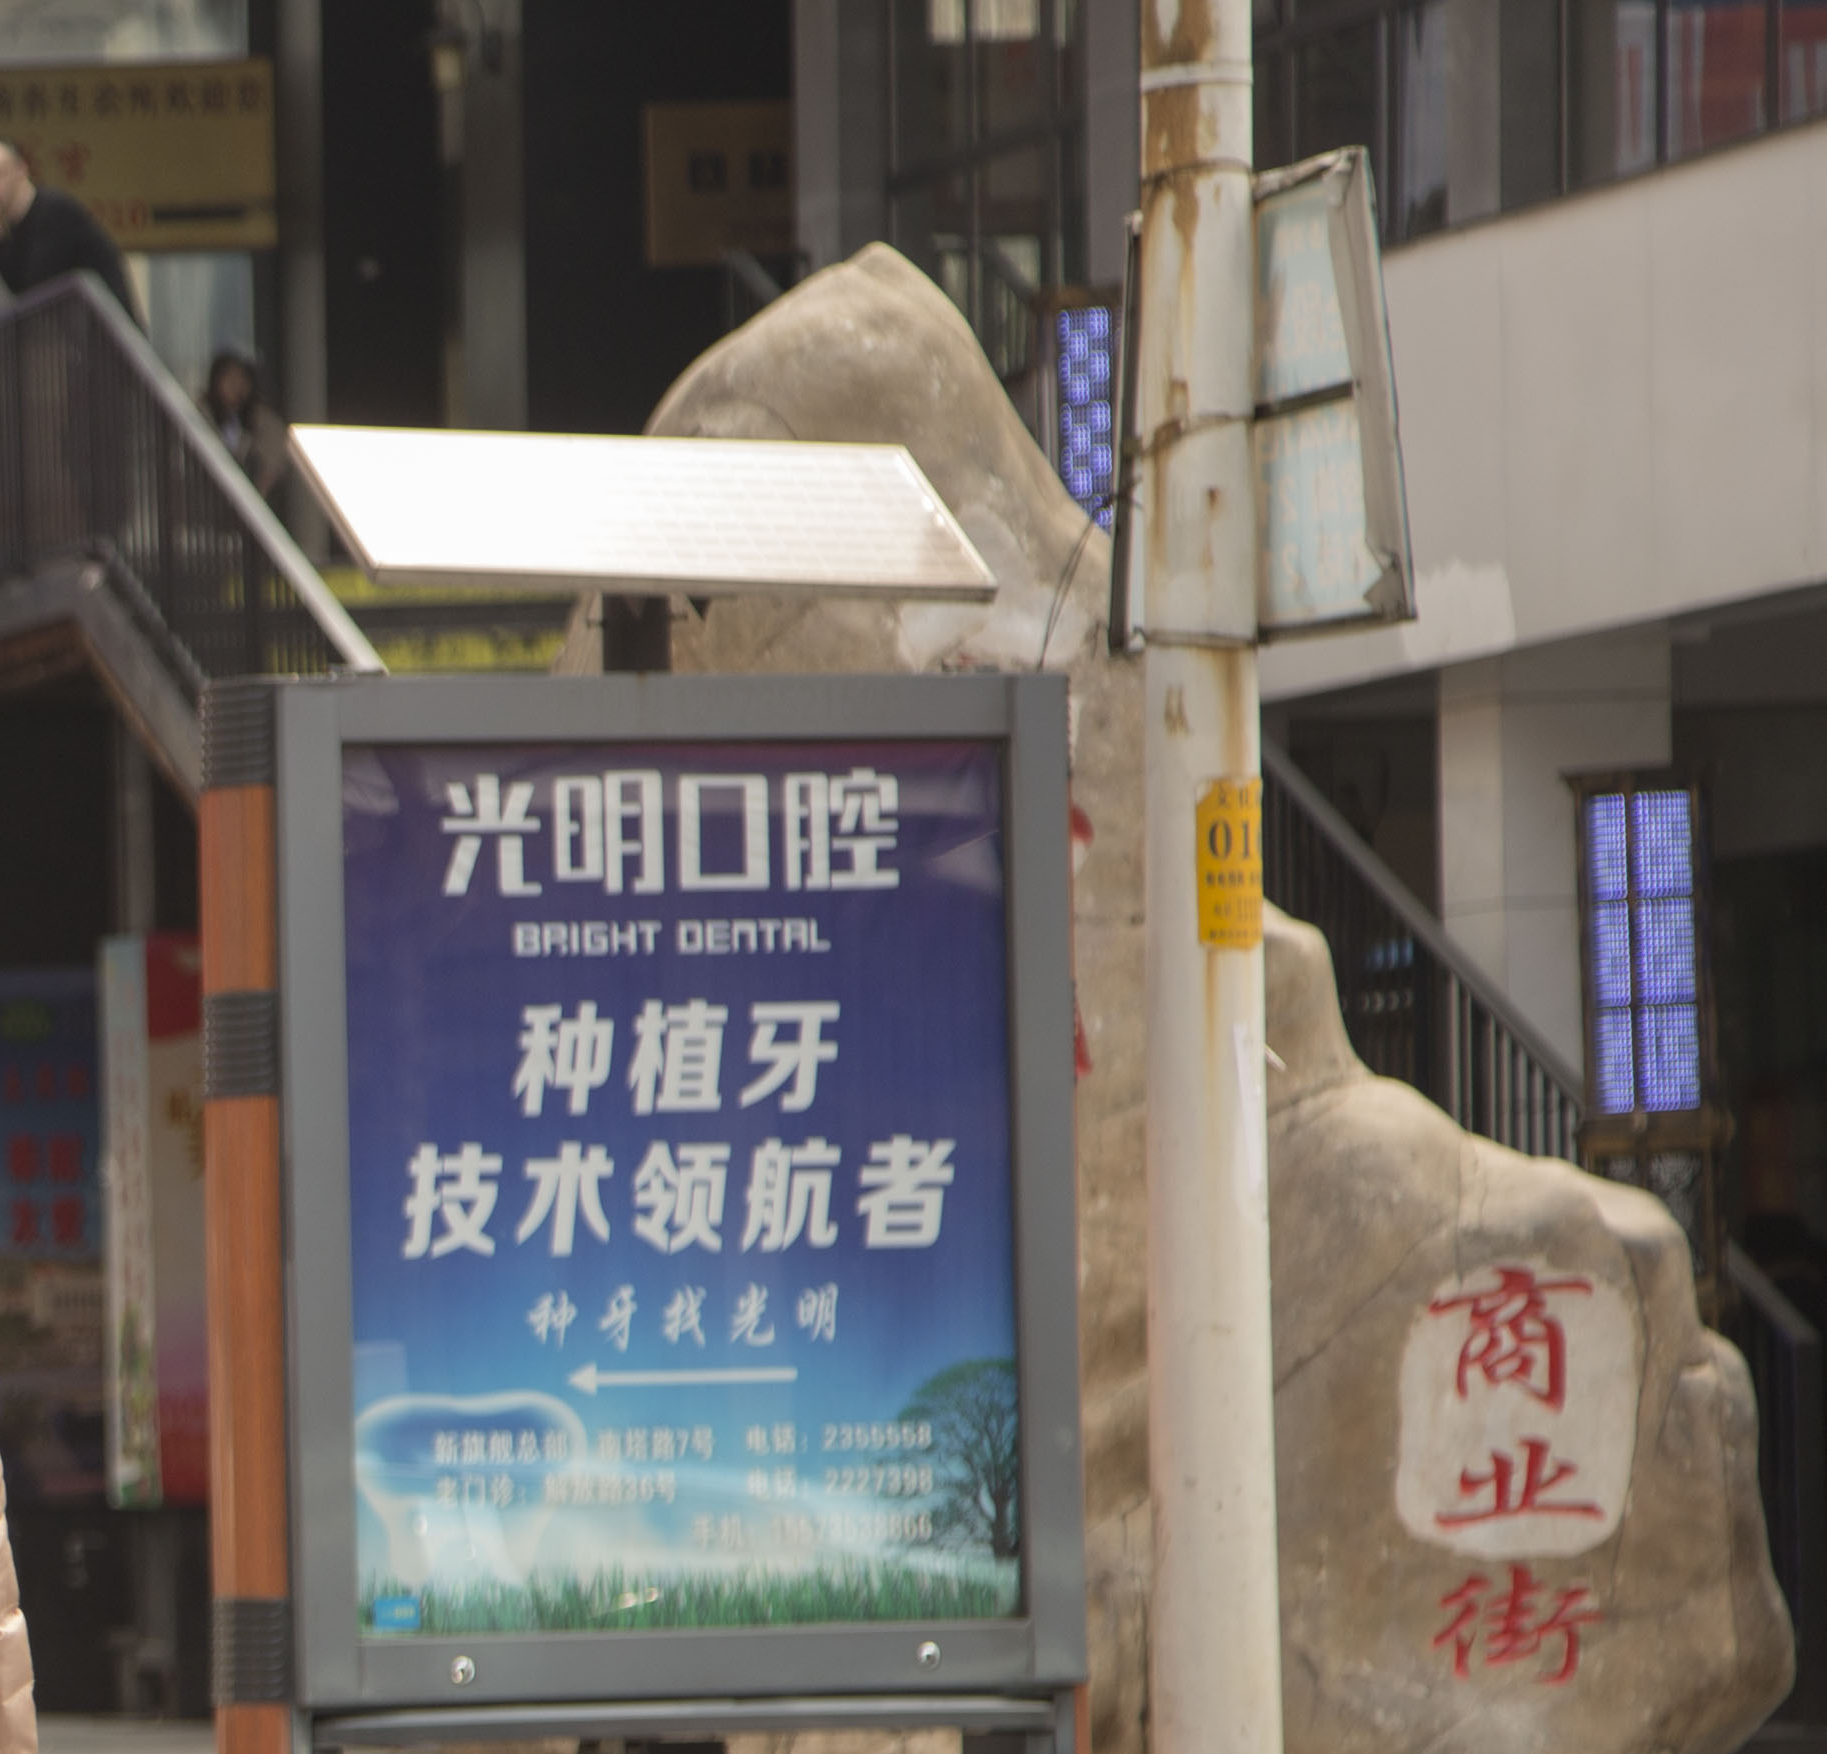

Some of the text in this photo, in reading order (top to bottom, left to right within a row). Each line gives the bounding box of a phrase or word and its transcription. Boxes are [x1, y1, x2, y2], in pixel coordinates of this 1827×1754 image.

[441, 766, 901, 898] 光明口腔
[1208, 819, 1262, 861] 01
[512, 916, 832, 957] BRIGHT DENTAL
[512, 997, 840, 1117] 种植牙
[402, 1133, 956, 1259] 技术领航者
[526, 1281, 839, 1351] 种牙找光明
[1429, 1267, 1605, 1685] 商业街
